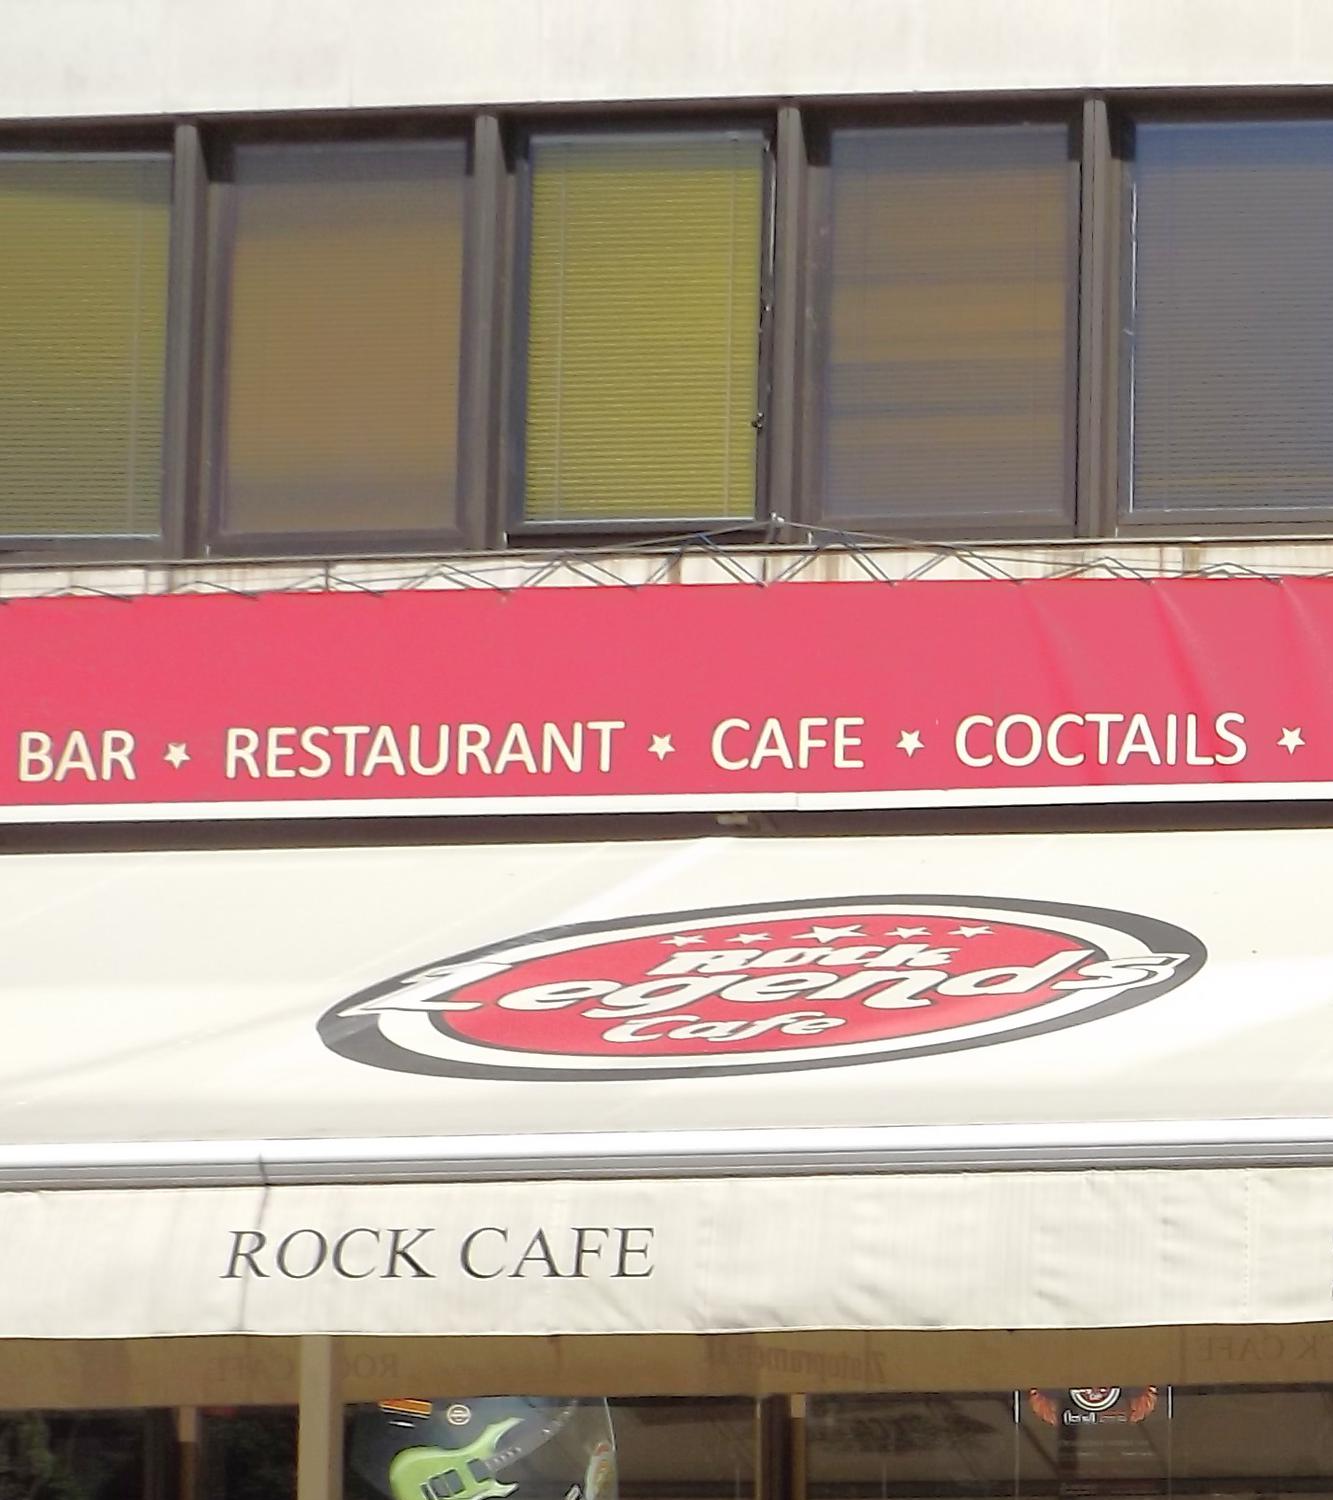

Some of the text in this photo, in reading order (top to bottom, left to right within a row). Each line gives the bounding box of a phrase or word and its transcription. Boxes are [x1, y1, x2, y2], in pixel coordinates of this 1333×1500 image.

[17, 729, 136, 783] BAR
[224, 720, 626, 780] RESTAURANT
[710, 716, 865, 772] CAFE
[953, 711, 1249, 768] COCTAILS
[337, 948, 1190, 1019] Legends
[601, 1010, 848, 1043] Cafe
[219, 1226, 656, 1280] ROCK CAFE
